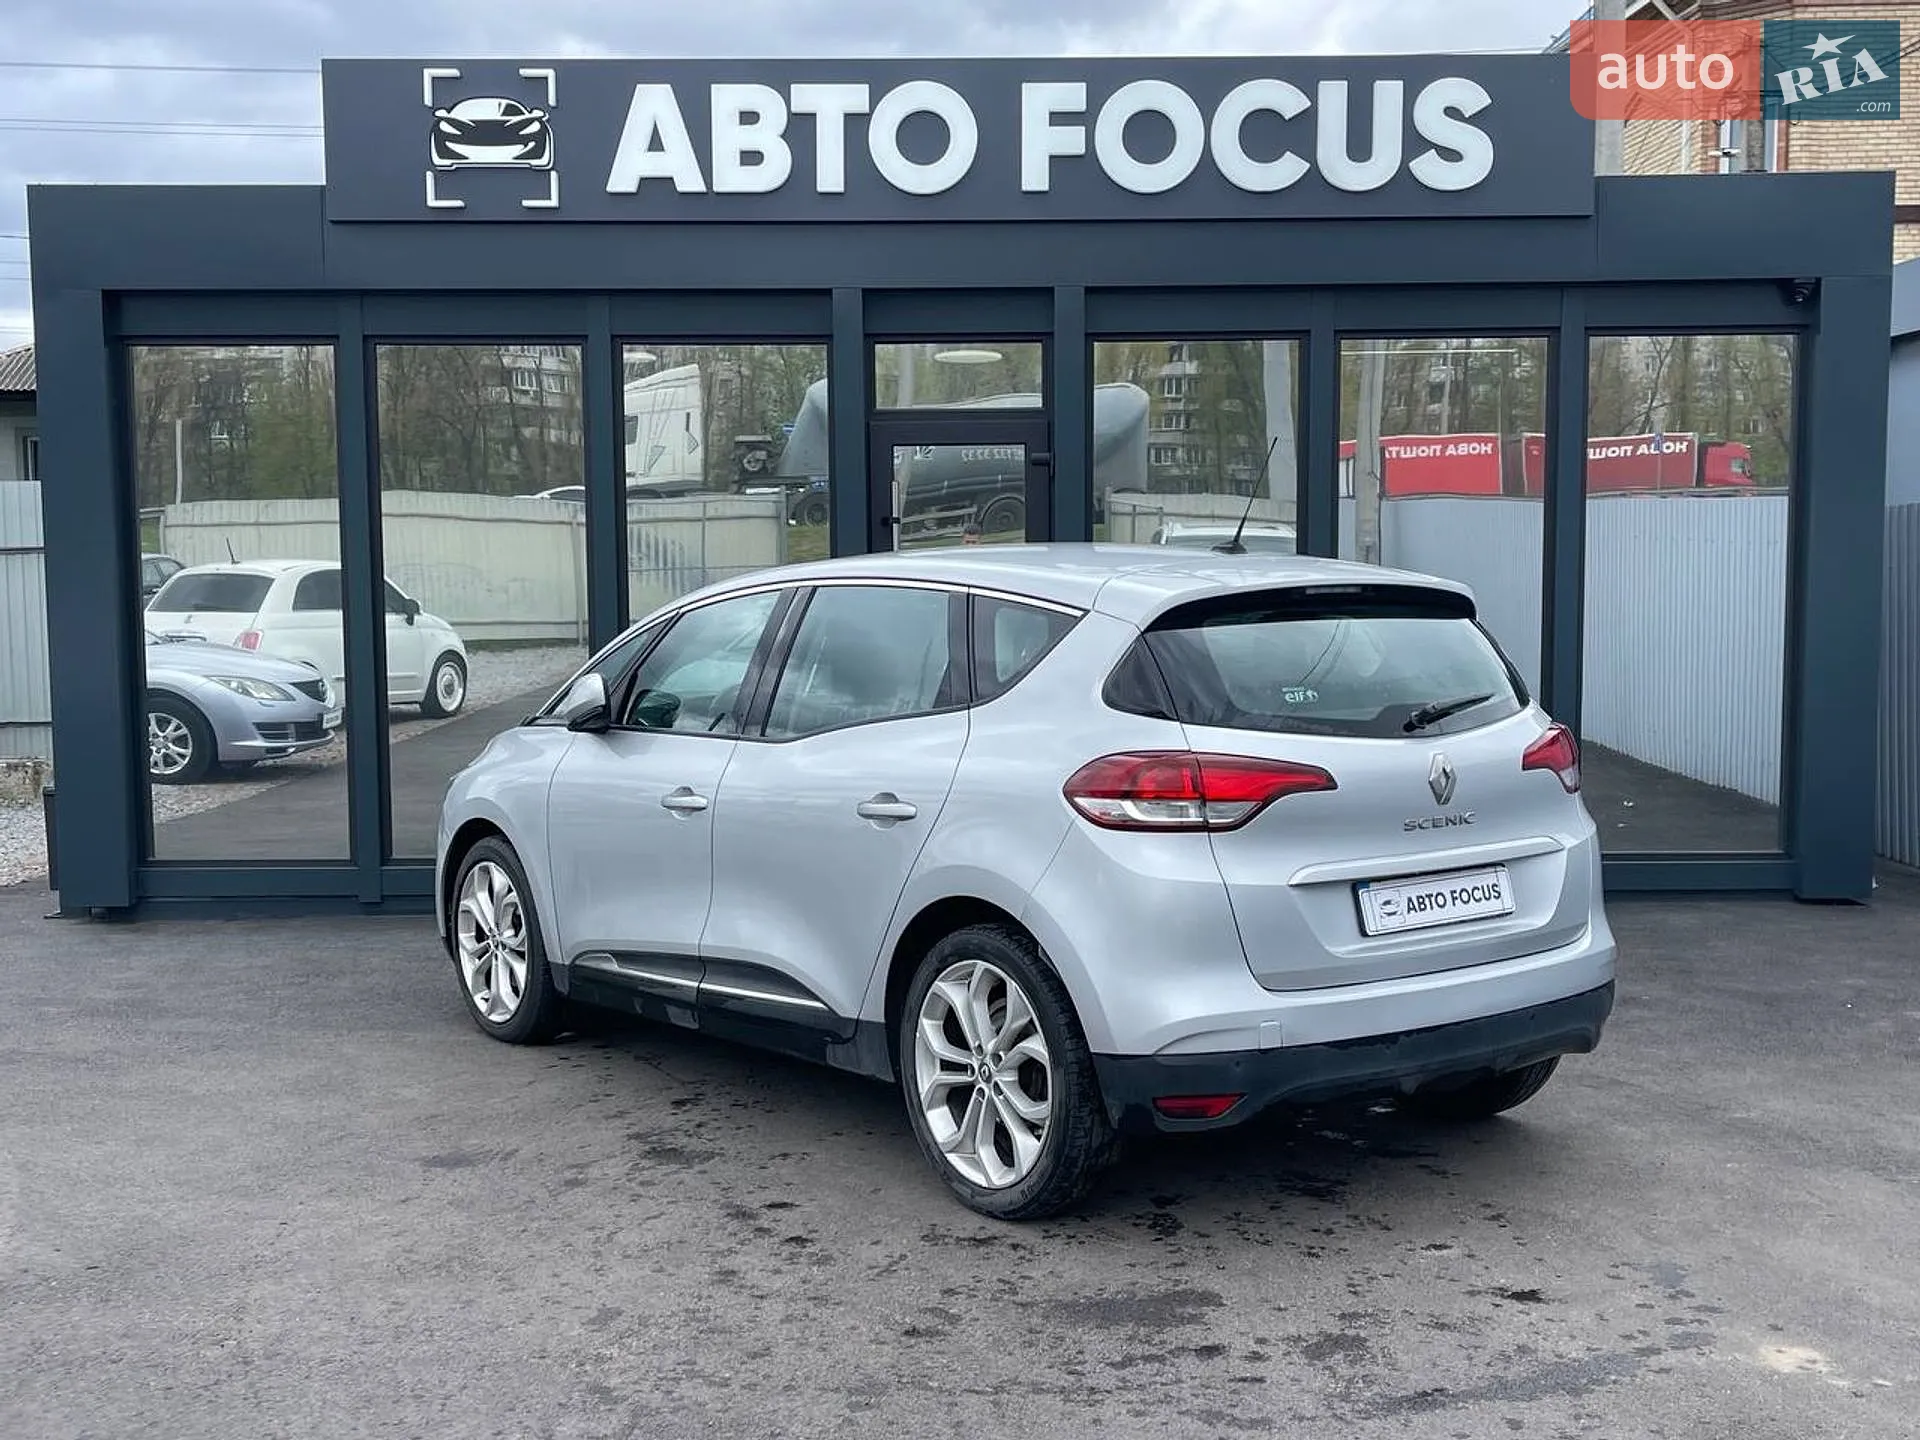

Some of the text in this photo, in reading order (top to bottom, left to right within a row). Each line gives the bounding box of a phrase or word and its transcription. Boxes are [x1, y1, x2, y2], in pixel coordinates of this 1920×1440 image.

[605, 77, 1495, 196] АВТО FOCUS
[1403, 811, 1476, 832] SCENIC
[1406, 882, 1502, 915] АВТО FOCUS
